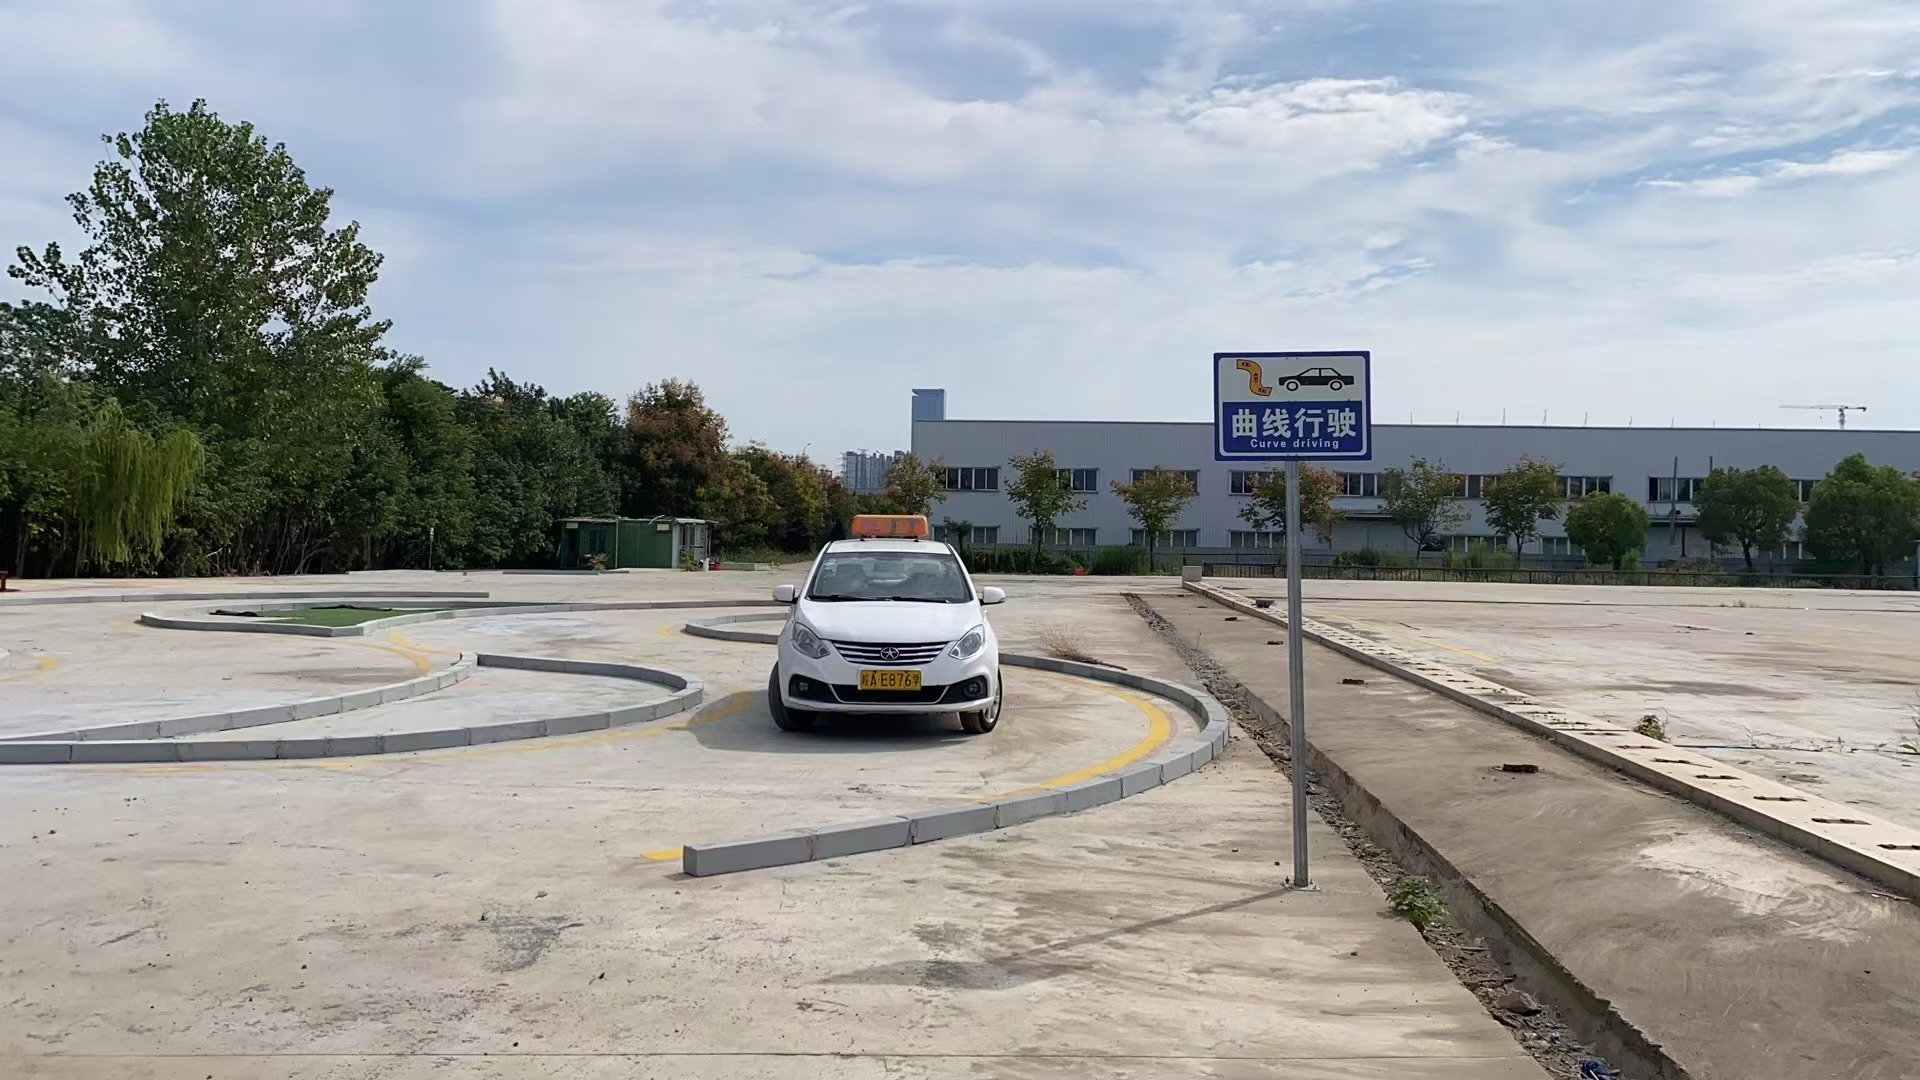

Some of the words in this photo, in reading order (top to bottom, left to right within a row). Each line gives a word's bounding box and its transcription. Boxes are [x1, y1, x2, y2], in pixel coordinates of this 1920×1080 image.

[1232, 408, 1356, 438] 曲线行驶
[1250, 439, 1287, 448] Curve
[1293, 439, 1339, 449] driving
